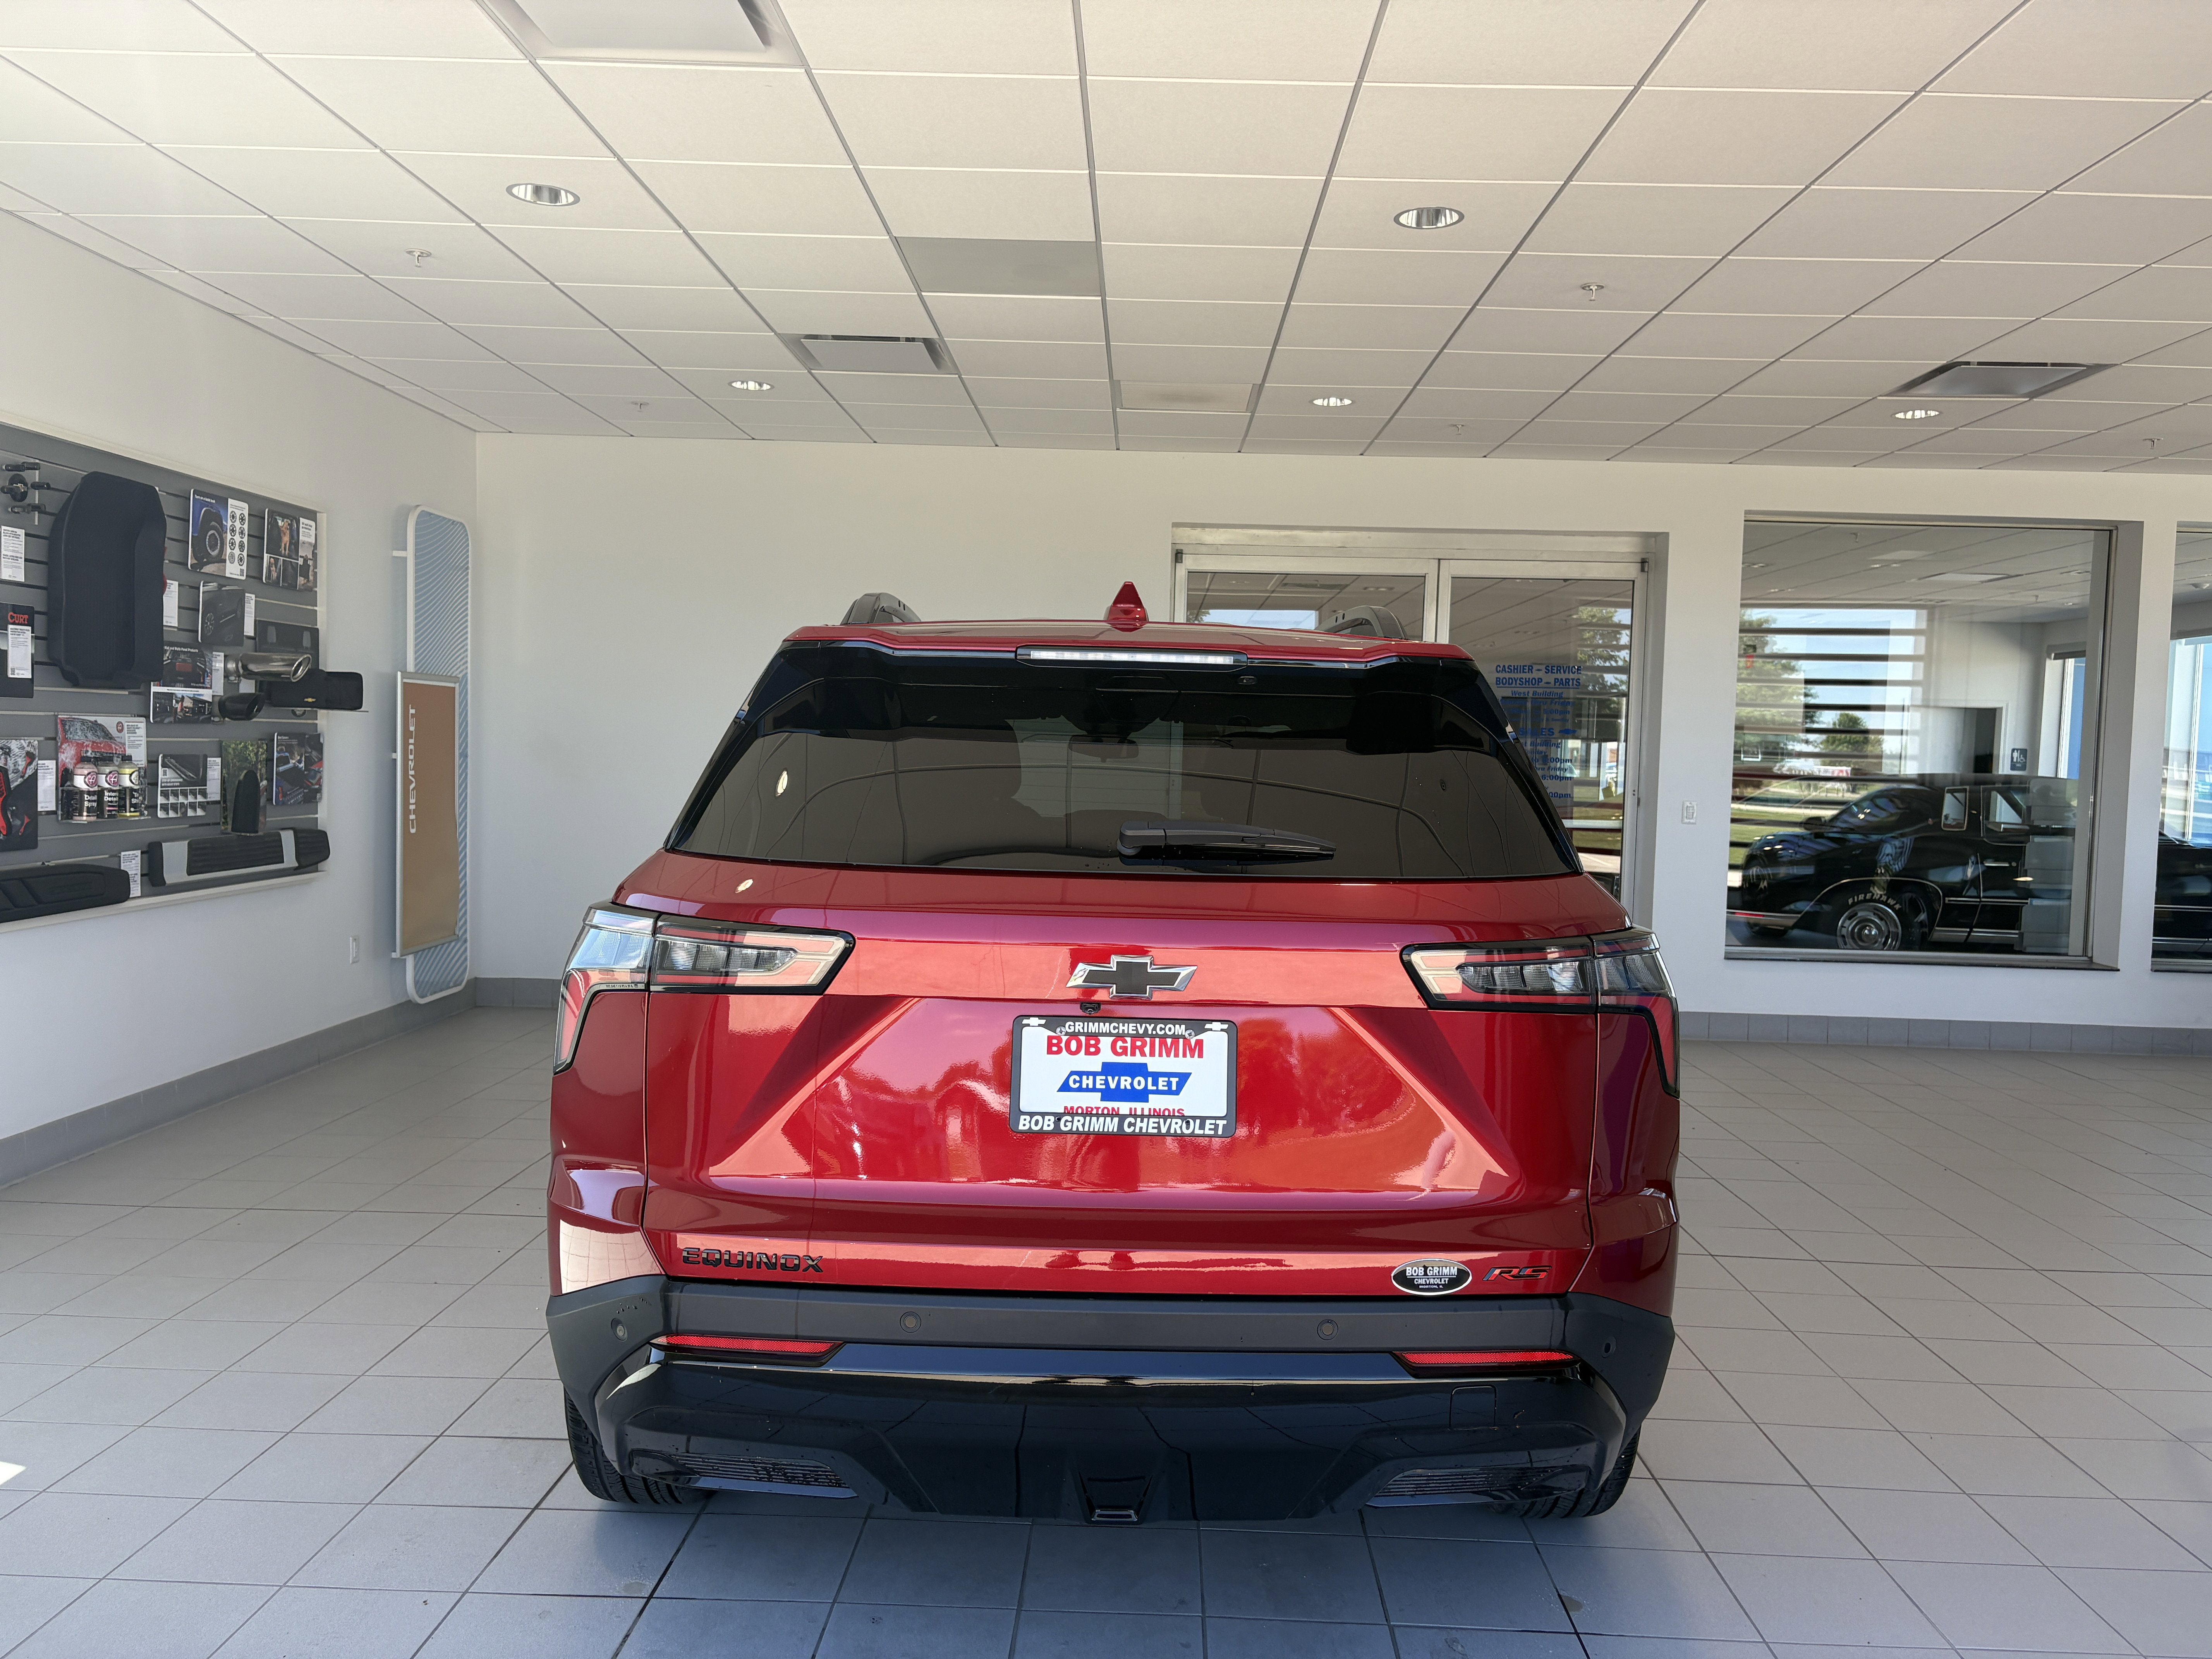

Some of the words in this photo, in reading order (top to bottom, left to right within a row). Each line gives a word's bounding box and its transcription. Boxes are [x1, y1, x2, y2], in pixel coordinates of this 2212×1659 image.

[8, 612, 29, 624] CURT
[1496, 665, 1534, 674] CASHIER
[1544, 665, 1582, 675] SERVICE
[1496, 677, 1543, 686] BODYSHOP
[1554, 678, 1581, 687] PARTS
[408, 704, 416, 834] CHEVROLET
[1848, 893, 1902, 910] FIREHAWK
[1065, 1021, 1186, 1036] GRIMMCHEVY.COM
[1046, 1035, 1101, 1056] BOB
[1110, 1036, 1204, 1059] GRIMM
[1068, 1075, 1180, 1091] CHEVROLET
[1018, 1115, 1055, 1131] BOB
[1059, 1116, 1118, 1132] GRIMM
[1123, 1117, 1227, 1135] CHEVROLET
[682, 1247, 823, 1273] EQUINOX
[1406, 1266, 1425, 1276] BOB
[1427, 1266, 1458, 1276] GRIMM
[1482, 1265, 1553, 1281] RS
